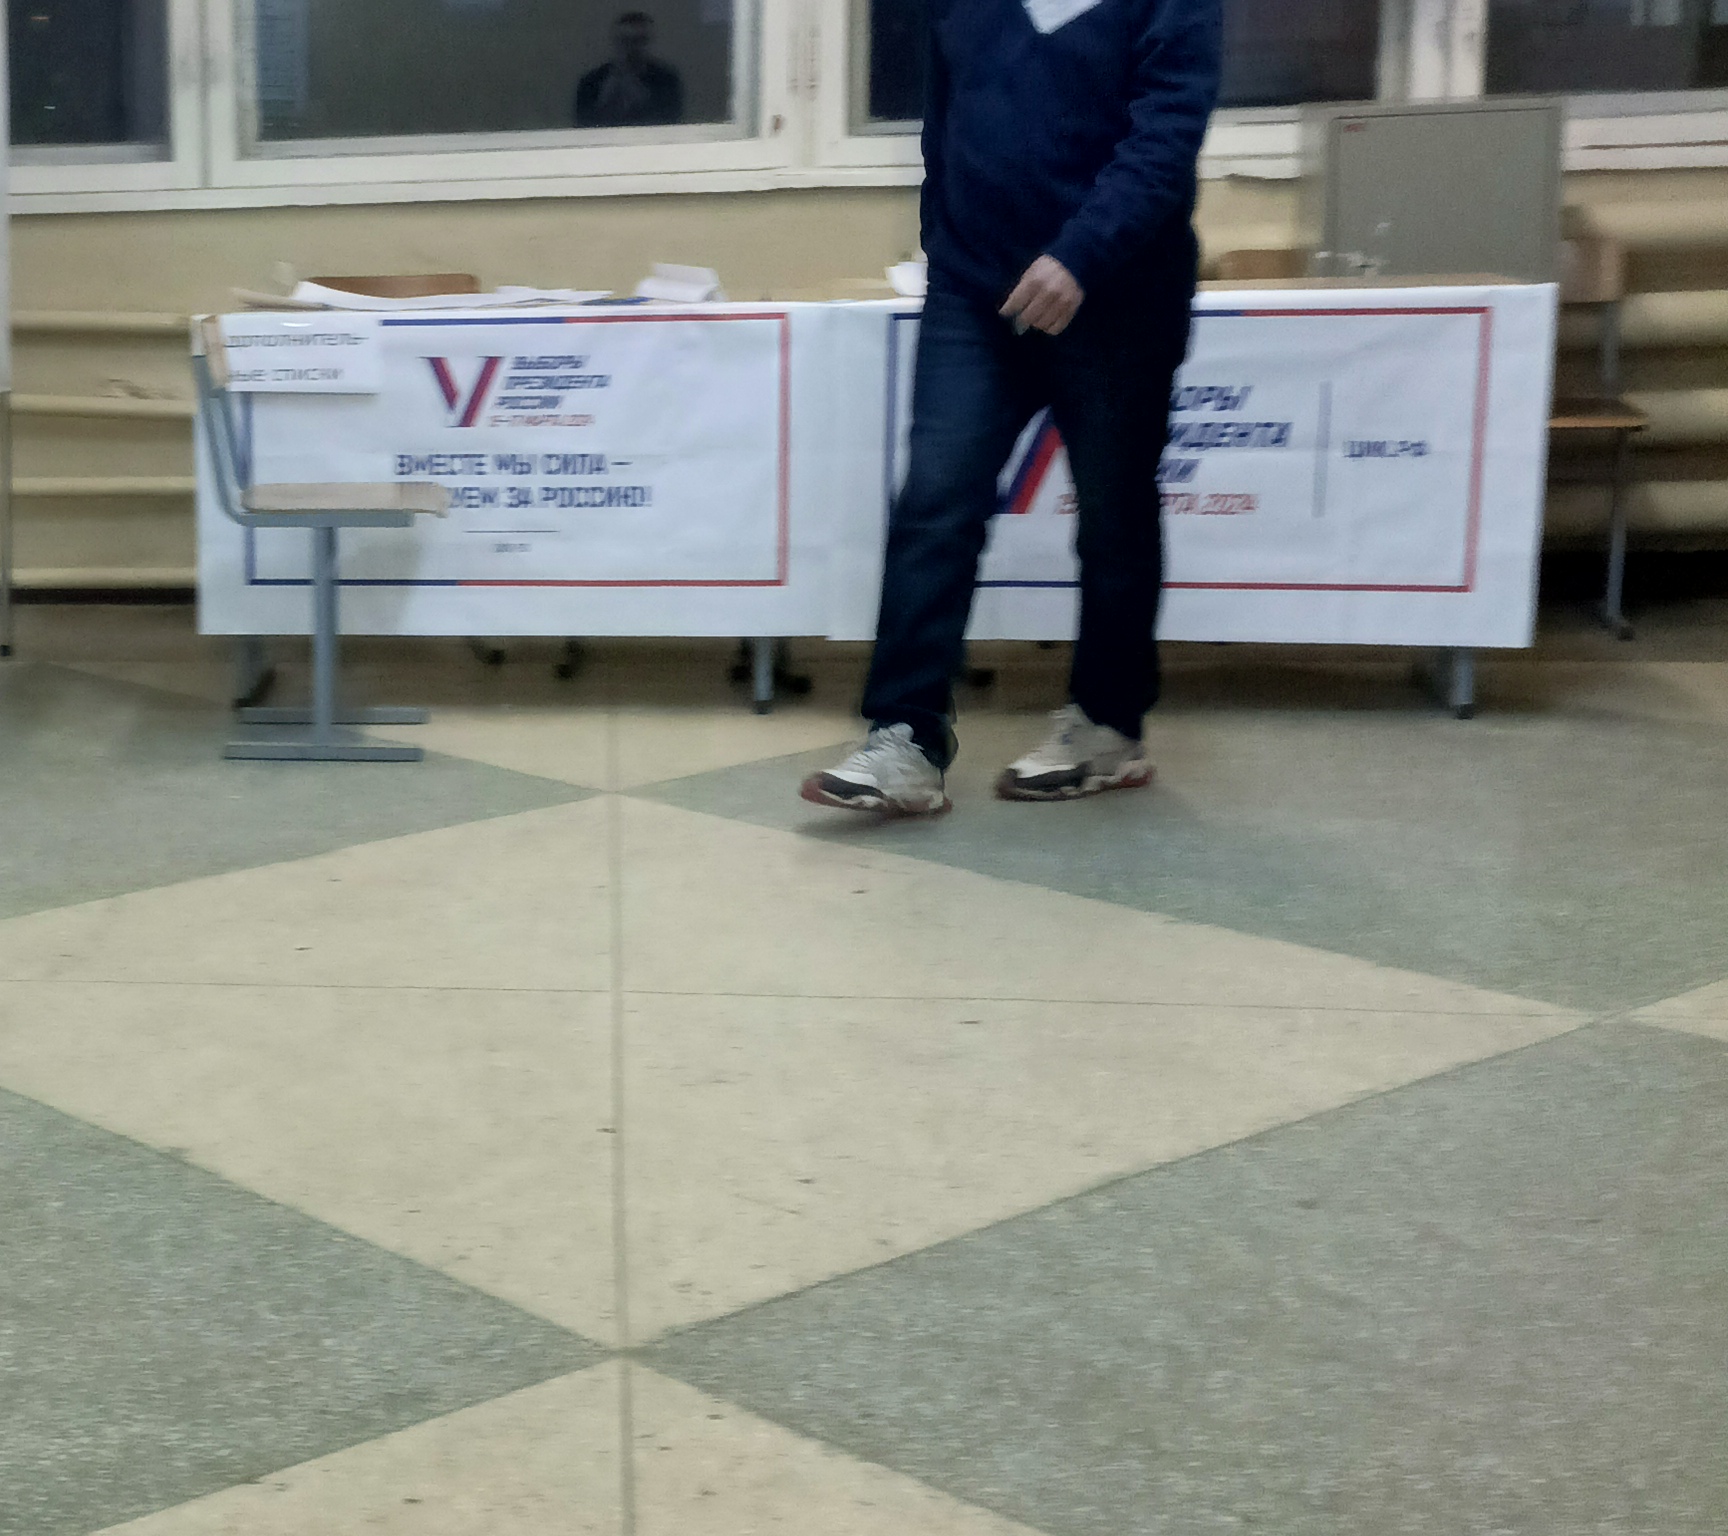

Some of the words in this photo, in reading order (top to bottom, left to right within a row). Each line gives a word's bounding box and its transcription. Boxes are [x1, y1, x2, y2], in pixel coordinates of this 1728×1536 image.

[395, 453, 489, 476] ВМЕСТЕ
[492, 453, 538, 476] МЫ
[542, 453, 610, 476] СИЛА
[503, 486, 533, 508] ЗА
[538, 485, 654, 508] РОССИЮ!
